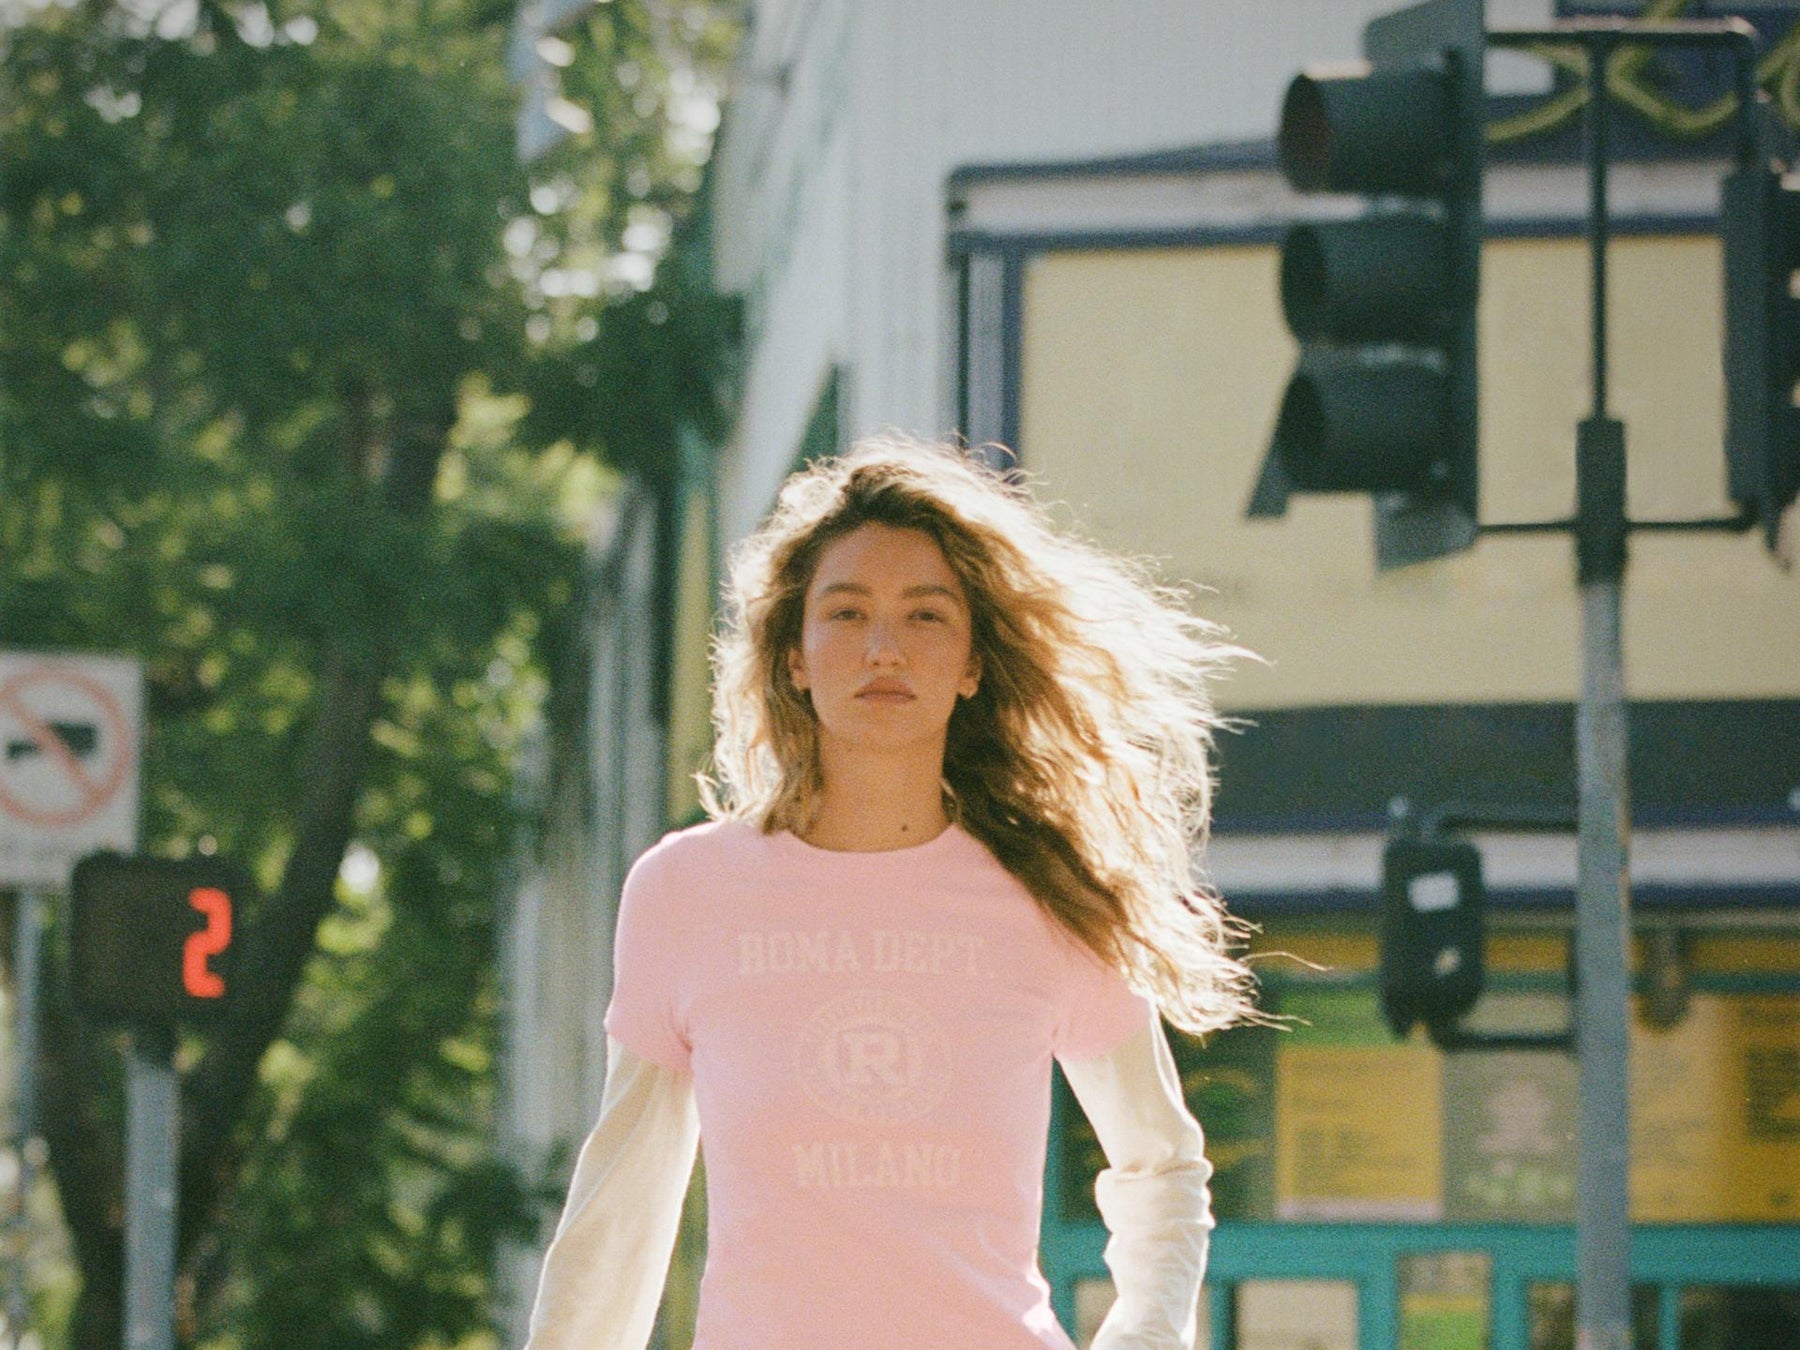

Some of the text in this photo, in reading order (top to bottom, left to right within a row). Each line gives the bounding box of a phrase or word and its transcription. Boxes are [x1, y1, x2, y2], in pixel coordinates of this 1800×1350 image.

[182, 887, 233, 999] 2
[737, 929, 996, 979] ROMA DEPT.
[841, 1031, 909, 1087] R
[791, 1141, 962, 1189] MILANO
